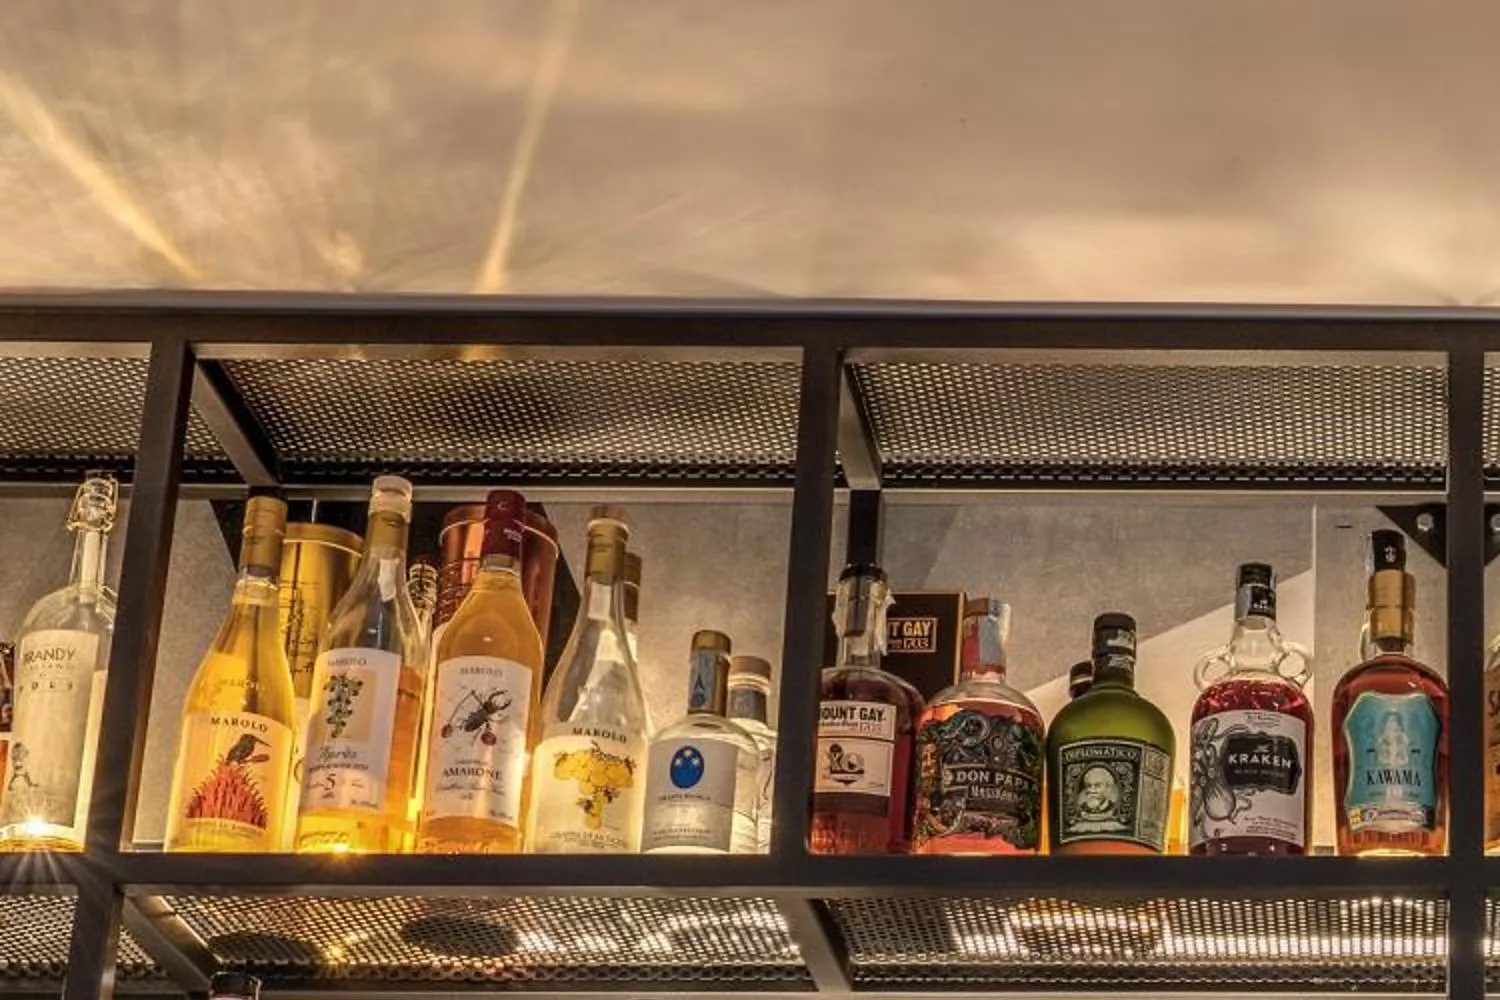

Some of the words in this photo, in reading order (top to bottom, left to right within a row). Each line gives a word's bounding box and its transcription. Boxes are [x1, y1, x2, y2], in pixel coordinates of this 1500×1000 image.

[903, 620, 931, 637] GAY
[819, 706, 856, 721] OUNT
[859, 706, 885, 721] GAY
[210, 715, 269, 733] MAROLO
[572, 727, 628, 743] MAROLO
[1228, 752, 1292, 769] KRAKEN
[956, 769, 990, 783] DON
[1366, 769, 1421, 787] KAWAMA
